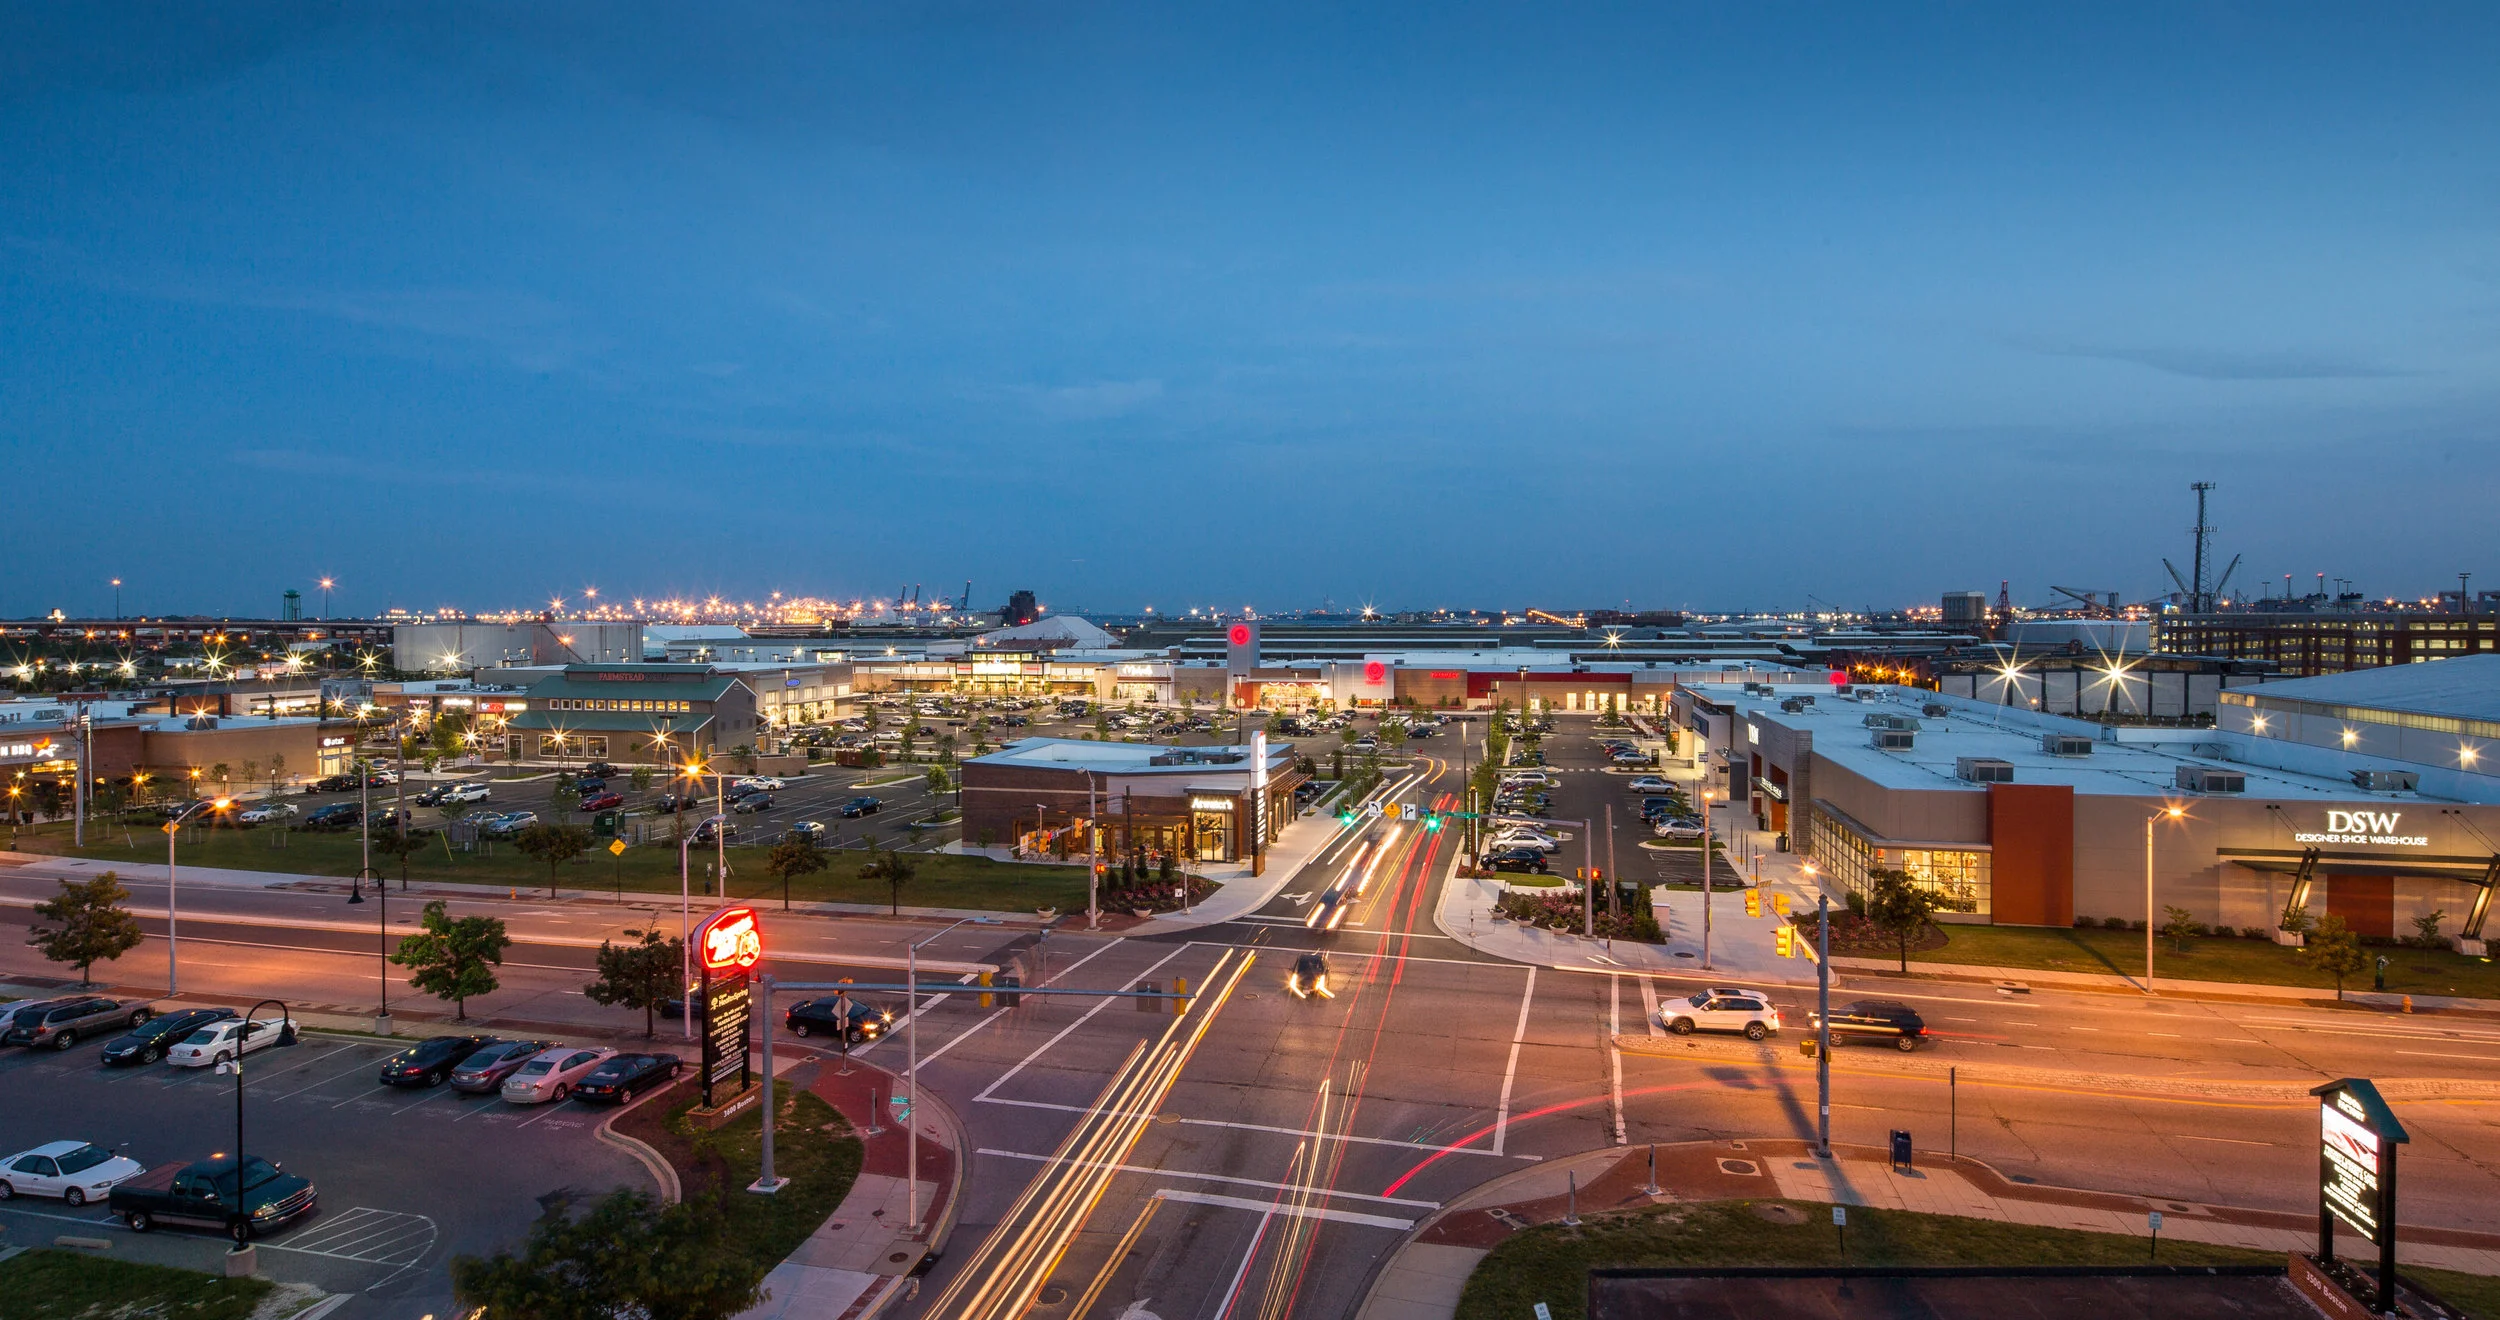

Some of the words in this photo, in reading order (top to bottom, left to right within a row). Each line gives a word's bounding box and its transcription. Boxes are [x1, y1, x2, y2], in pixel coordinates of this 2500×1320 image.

[599, 672, 645, 681] FARMSTEAD
[11, 744, 33, 756] BBQ
[2328, 810, 2401, 834] DSW
[2295, 833, 2341, 844] DESIGNER
[2341, 835, 2367, 844] SHOE
[2369, 836, 2428, 846] WAREHOUSE
[723, 1105, 737, 1118] 3600
[737, 1095, 755, 1109] Boston
[2305, 1271, 2322, 1290] 3500
[2323, 1285, 2348, 1313] Boston
